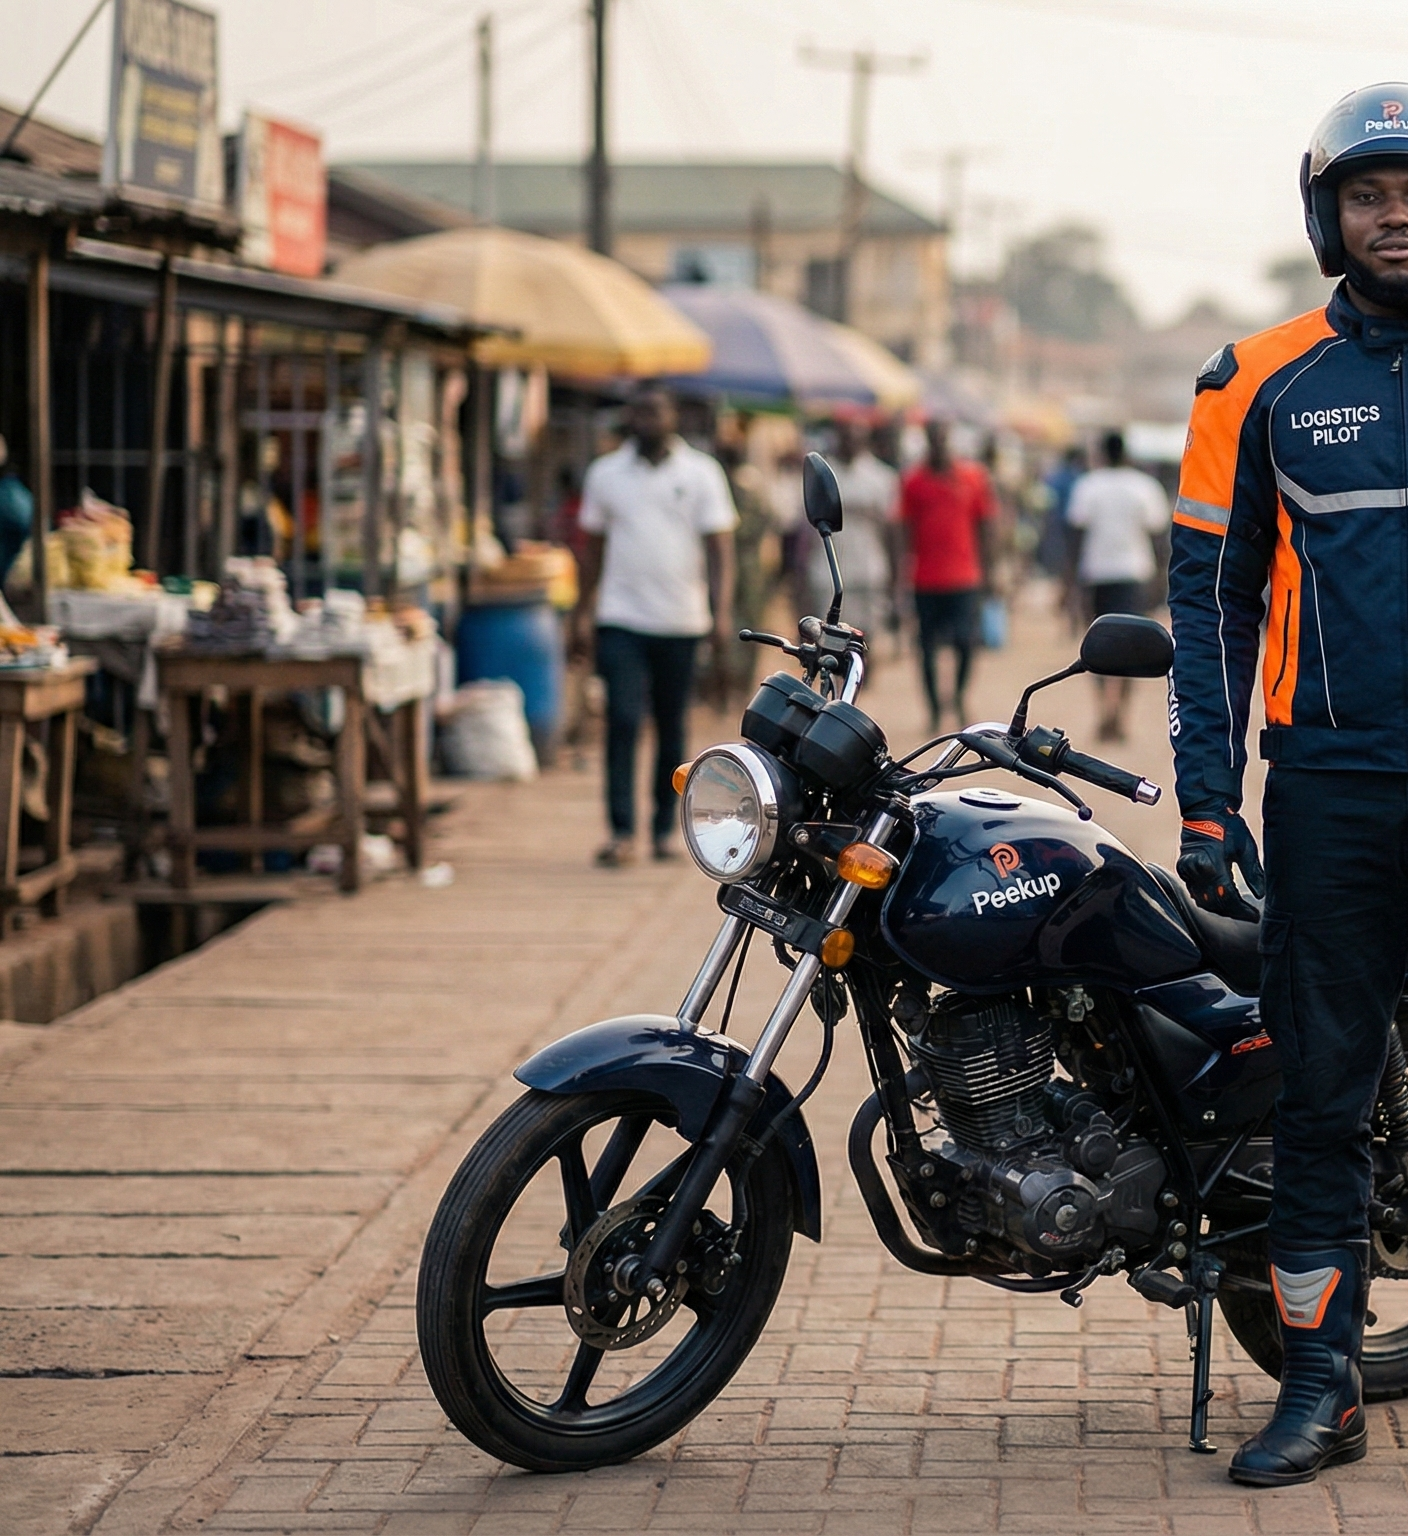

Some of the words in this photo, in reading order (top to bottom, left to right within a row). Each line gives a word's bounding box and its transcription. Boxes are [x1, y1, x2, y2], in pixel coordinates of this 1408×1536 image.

[1290, 405, 1381, 430] LOGISTICS
[1313, 426, 1362, 446] PILOT
[972, 872, 1061, 915] Peekup
